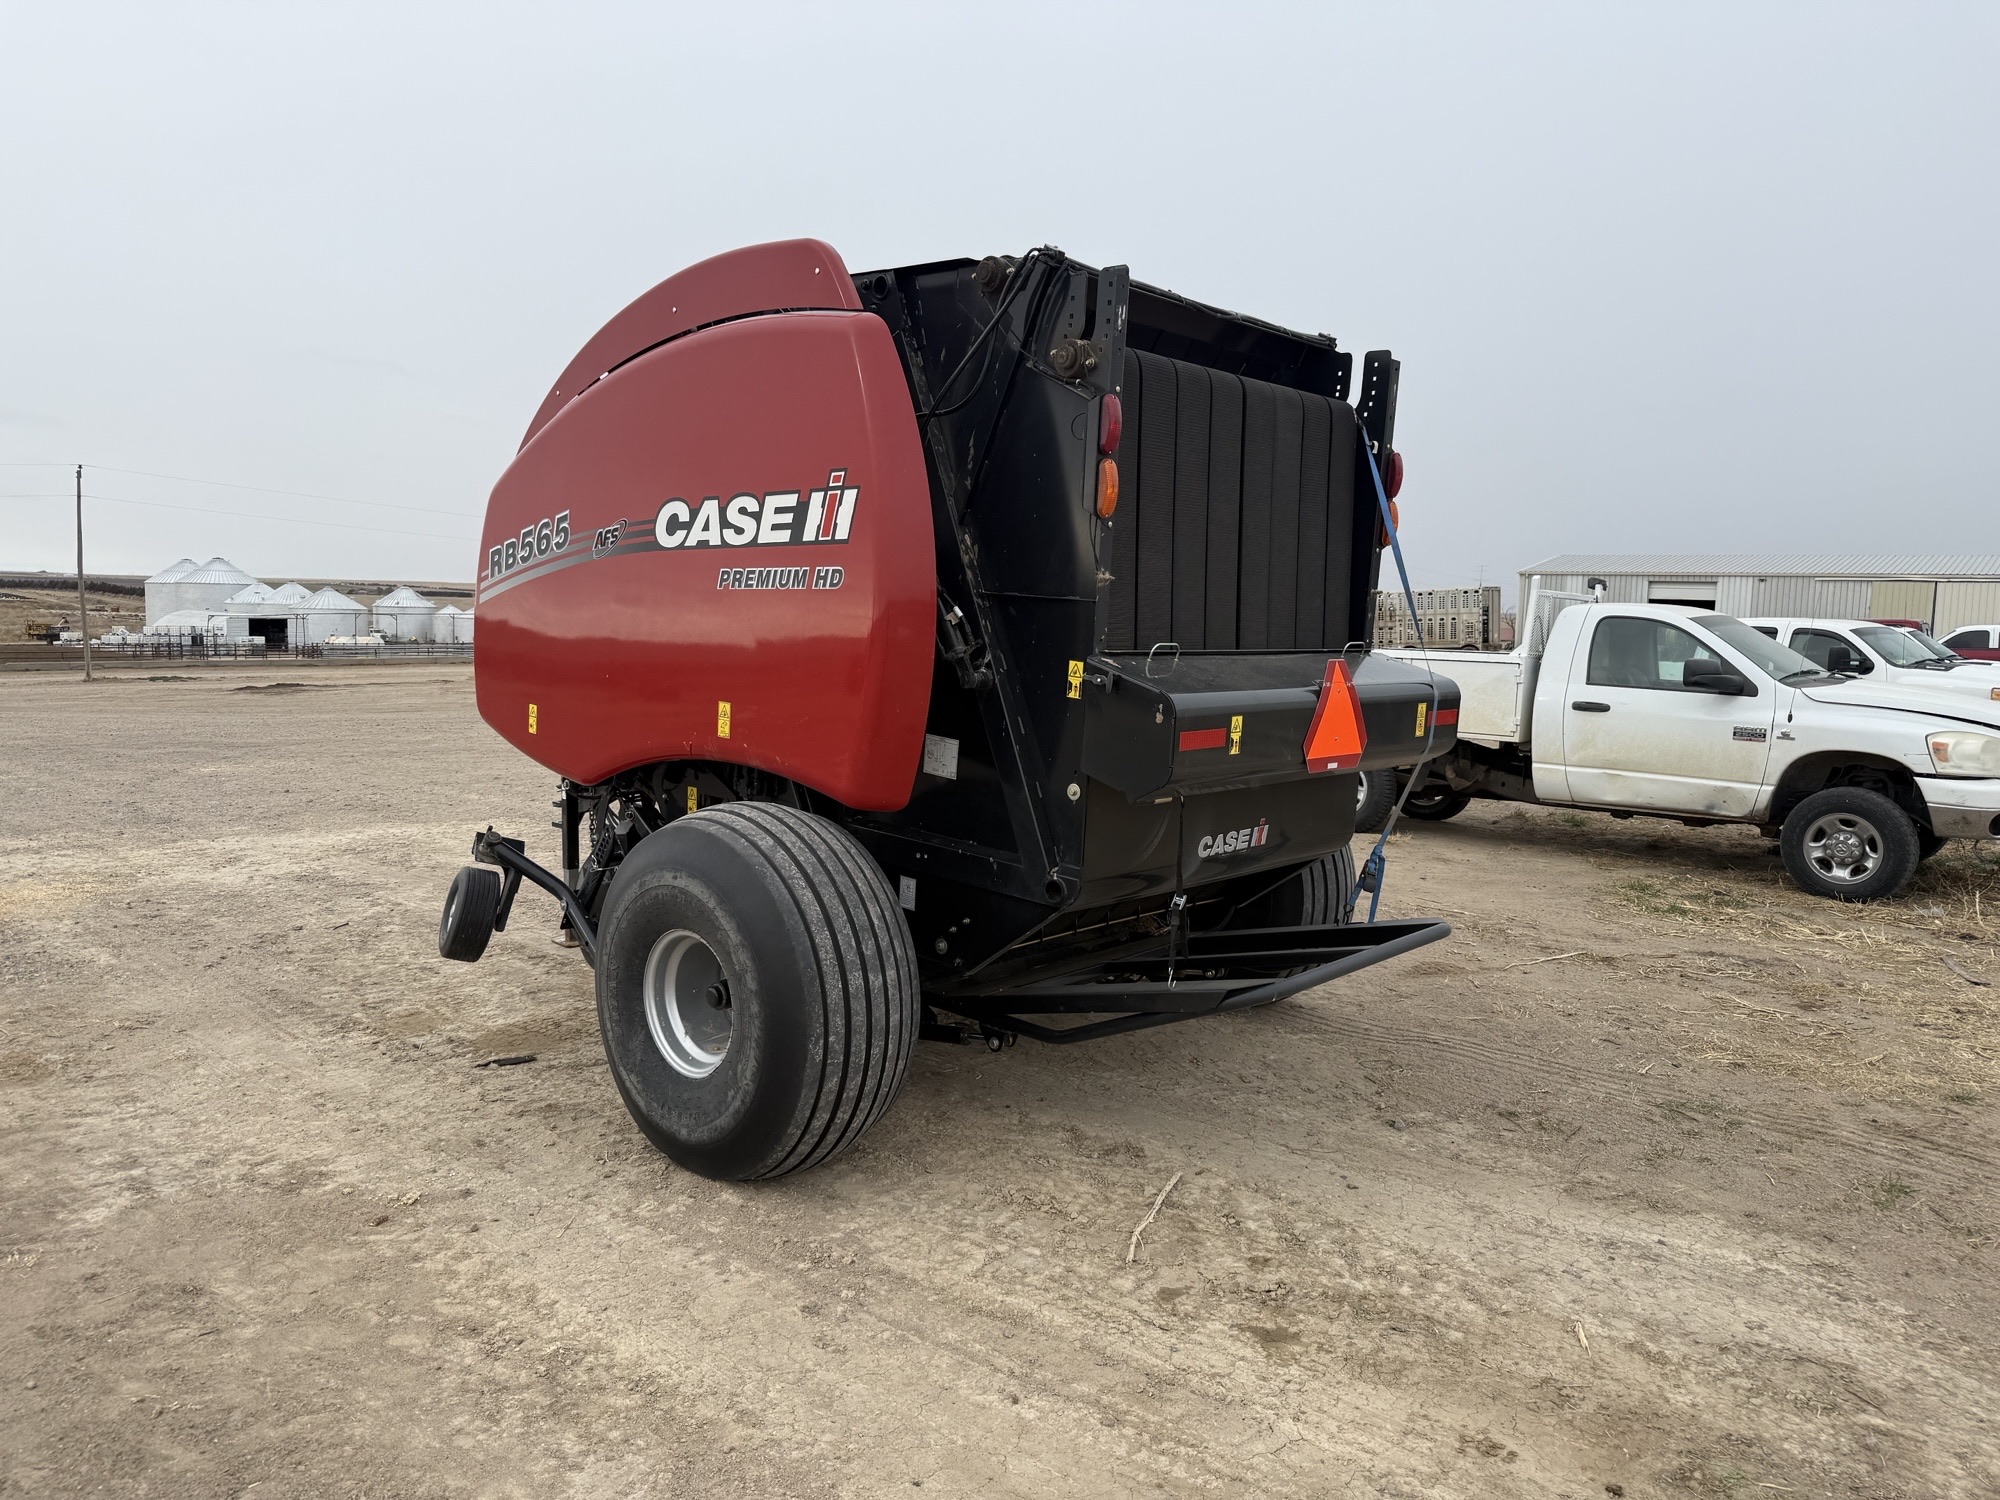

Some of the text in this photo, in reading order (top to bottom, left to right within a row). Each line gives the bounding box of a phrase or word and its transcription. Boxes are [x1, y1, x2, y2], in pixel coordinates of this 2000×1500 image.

[655, 493, 800, 548] CASE
[488, 509, 571, 581] RB565
[593, 524, 621, 551] AFS
[717, 566, 845, 590] PREMIUM HD
[1197, 828, 1252, 858] CASE
